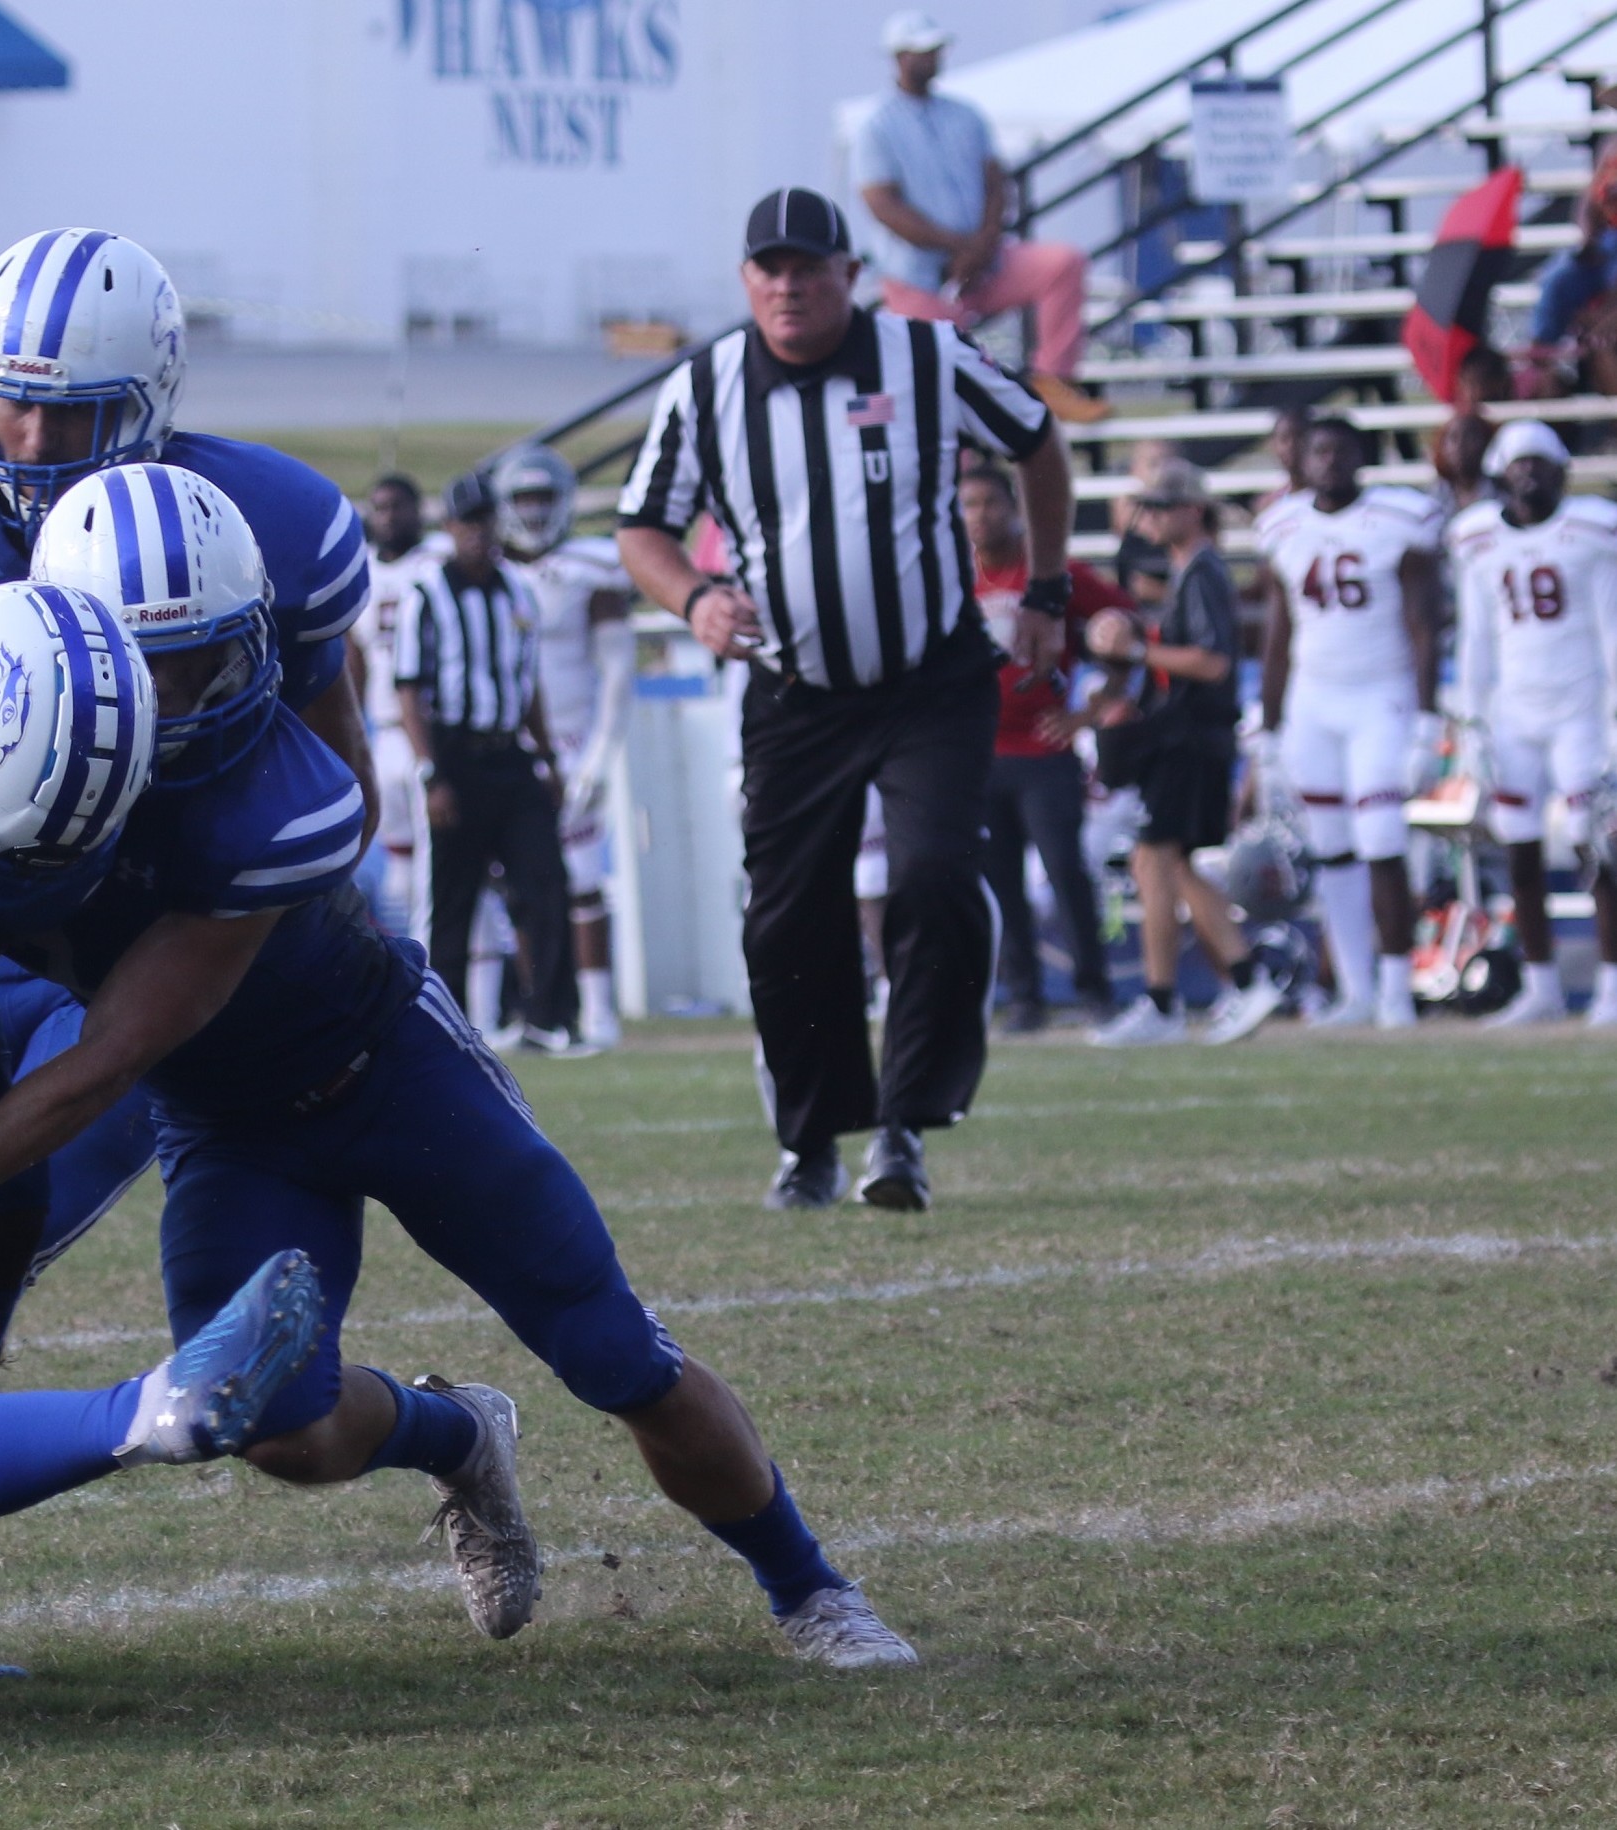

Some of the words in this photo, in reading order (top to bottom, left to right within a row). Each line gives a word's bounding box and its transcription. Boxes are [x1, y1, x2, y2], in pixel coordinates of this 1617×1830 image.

[431, 0, 680, 86] HAWKS
[488, 91, 629, 166] NEST
[8, 359, 52, 375] Riddell
[864, 451, 889, 482] U
[1302, 552, 1369, 609] 46
[139, 604, 188, 623] Riddell
